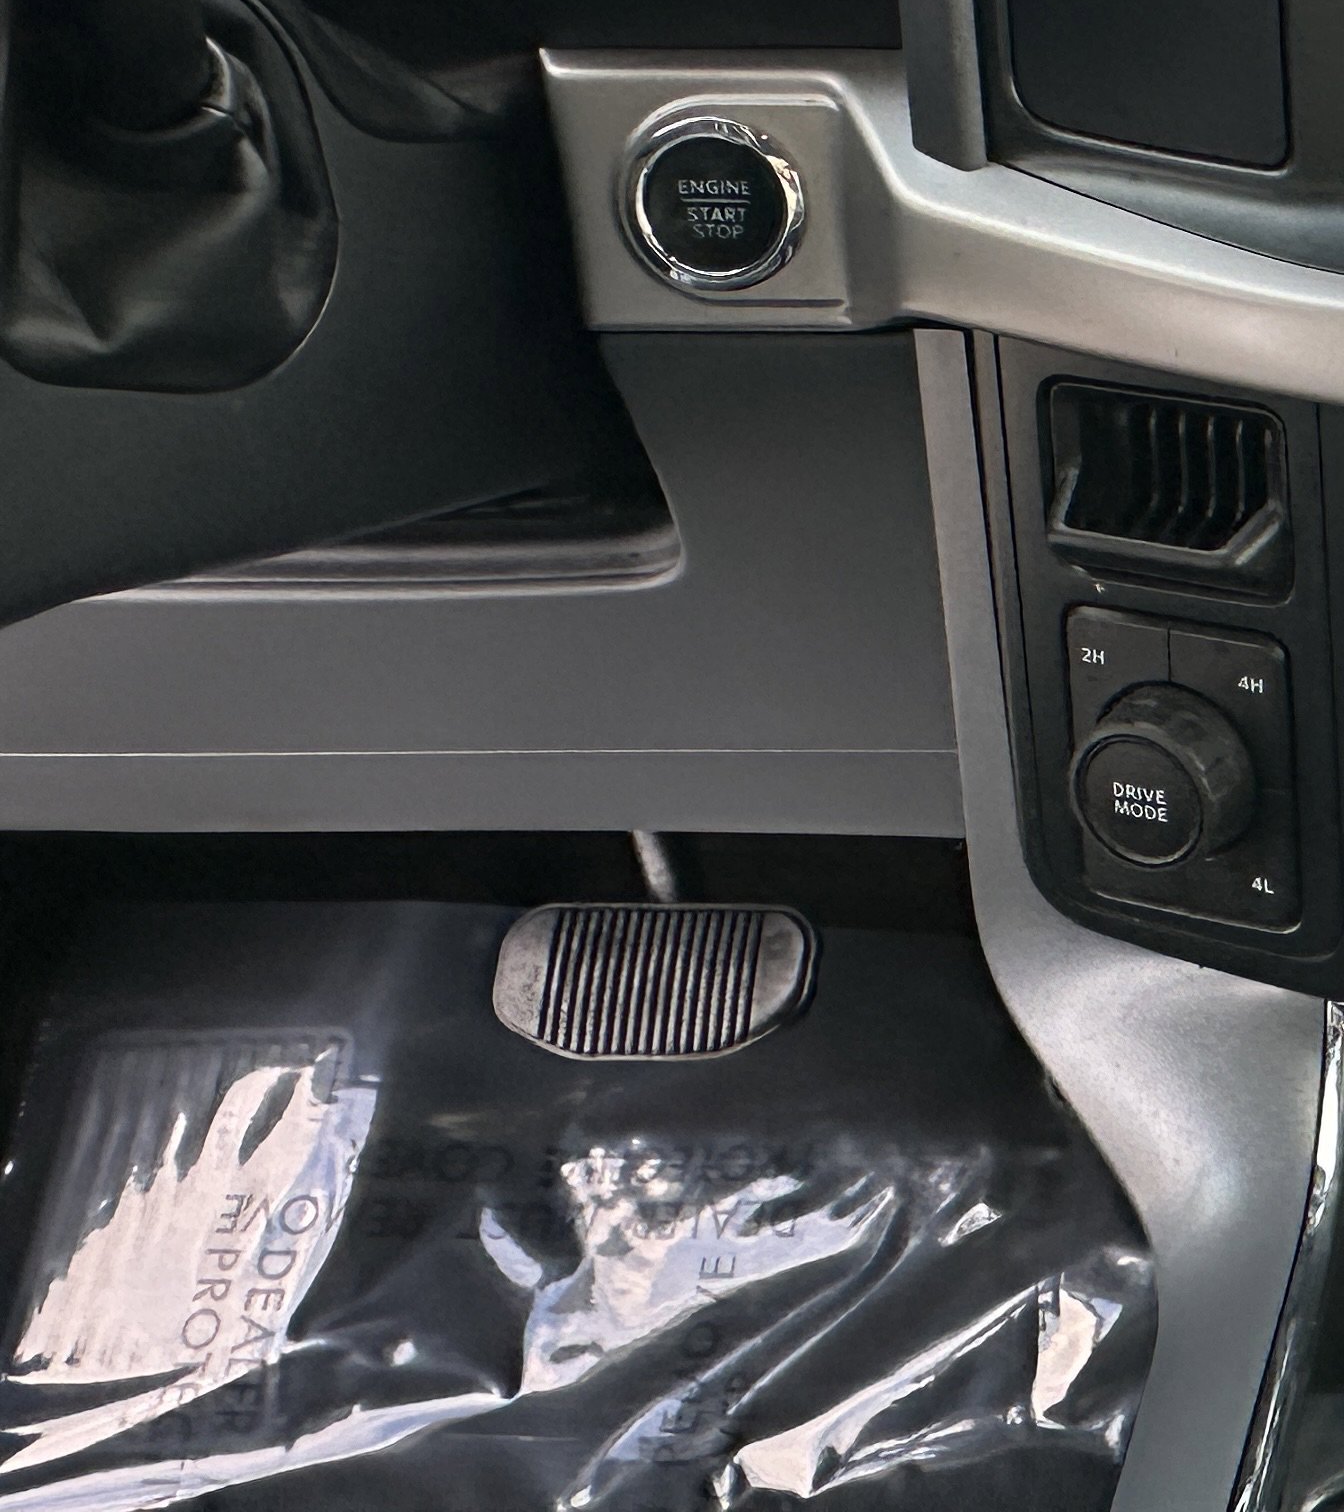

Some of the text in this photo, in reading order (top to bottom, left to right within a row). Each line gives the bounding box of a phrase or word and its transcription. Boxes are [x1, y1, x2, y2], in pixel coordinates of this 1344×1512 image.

[678, 179, 750, 195] ENGINE
[687, 206, 745, 223] START
[693, 223, 743, 239] STOP
[1081, 647, 1105, 665] 2H
[1237, 676, 1263, 694] 4H
[1113, 781, 1166, 806] DRIVE
[1114, 799, 1168, 822] MODE
[1251, 877, 1275, 895] 4L
